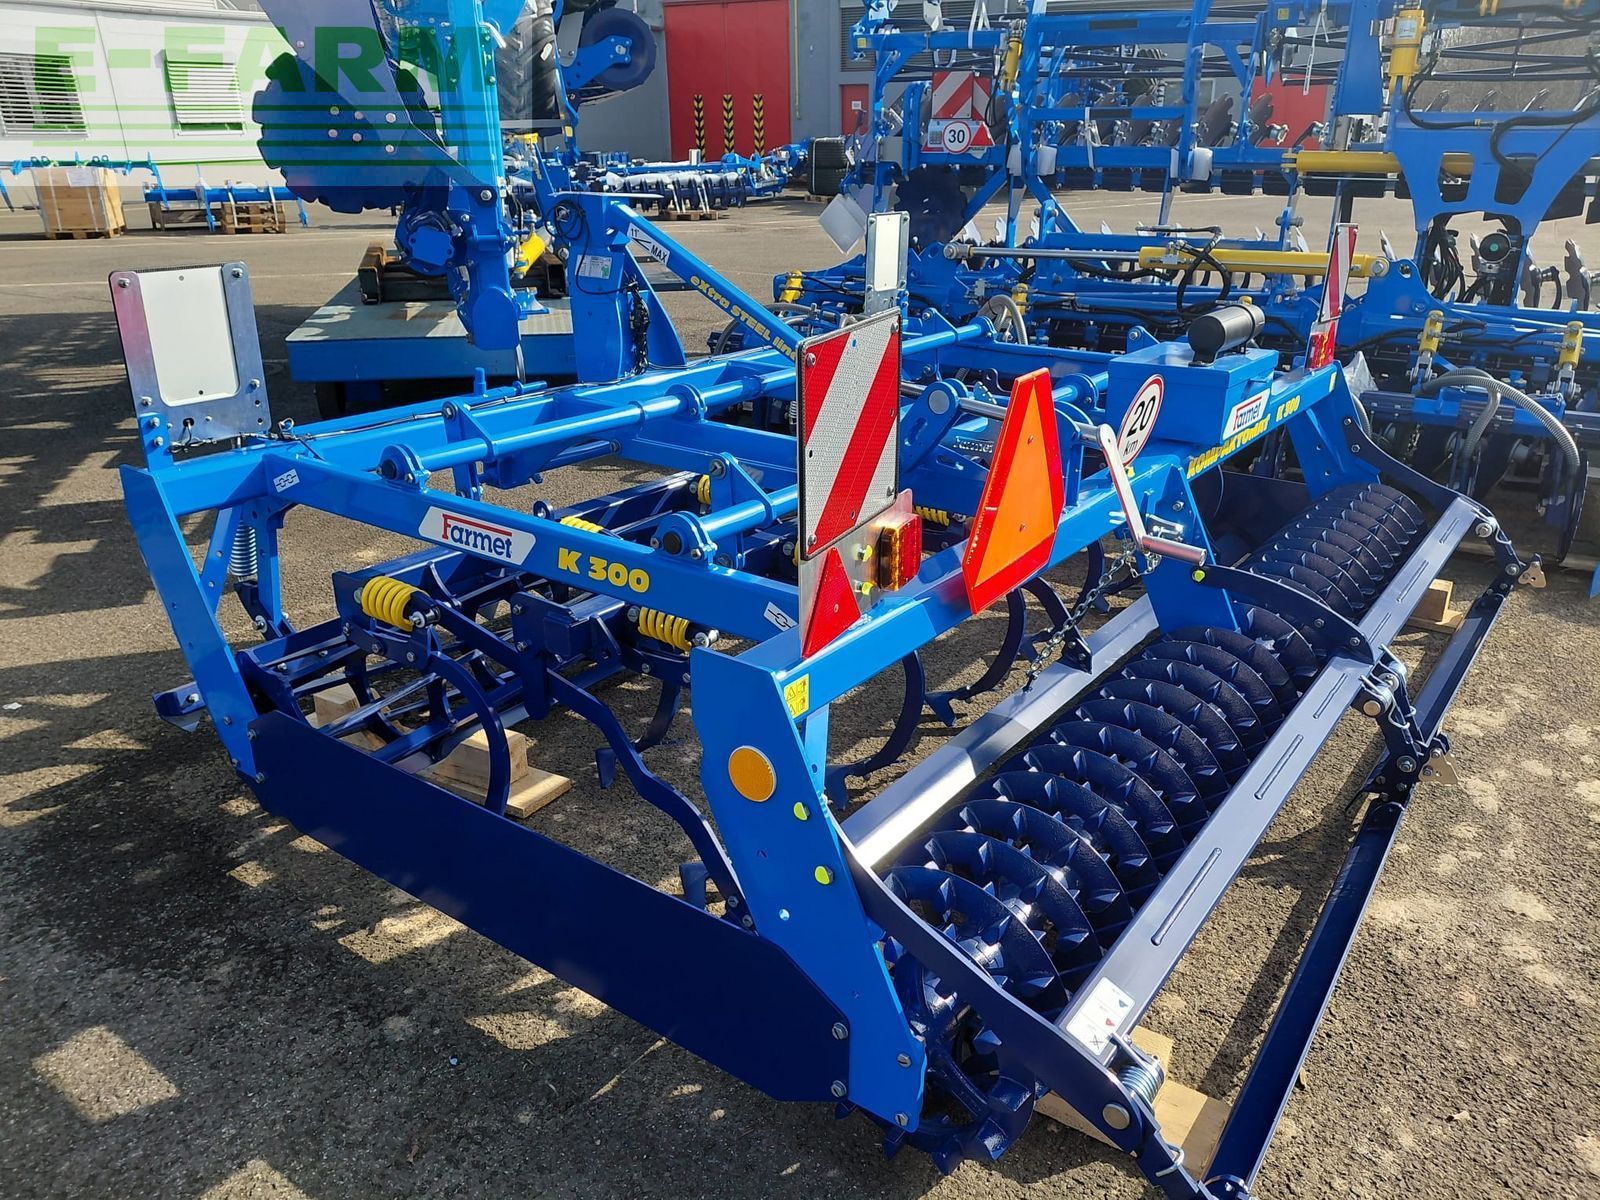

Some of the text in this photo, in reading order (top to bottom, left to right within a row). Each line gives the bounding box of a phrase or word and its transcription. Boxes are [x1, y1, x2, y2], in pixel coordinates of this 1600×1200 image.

[948, 129, 965, 143] 30
[650, 244, 667, 263] MAX
[730, 304, 770, 341] STEEL
[1126, 395, 1157, 437] 20
[1284, 395, 1300, 417] 300
[1123, 438, 1138, 457] km
[441, 513, 513, 558] Farmet
[557, 547, 650, 593] K 300
